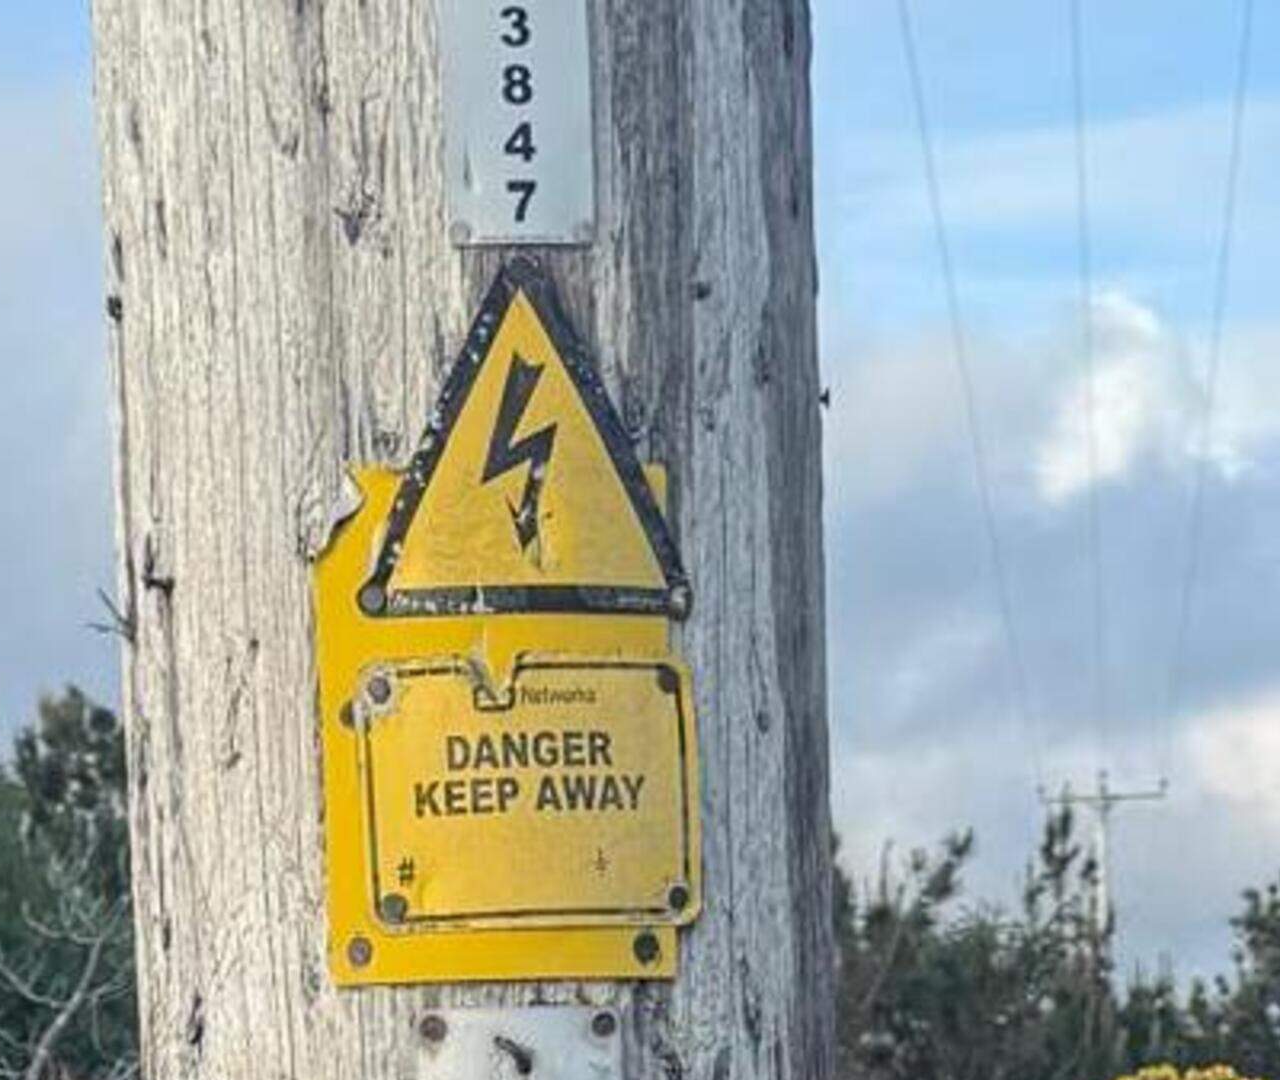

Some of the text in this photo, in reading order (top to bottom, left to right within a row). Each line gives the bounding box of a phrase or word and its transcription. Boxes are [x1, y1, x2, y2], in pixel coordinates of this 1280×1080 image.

[446, 731, 614, 772] DANGER
[414, 774, 646, 818] KEEP AWAY
